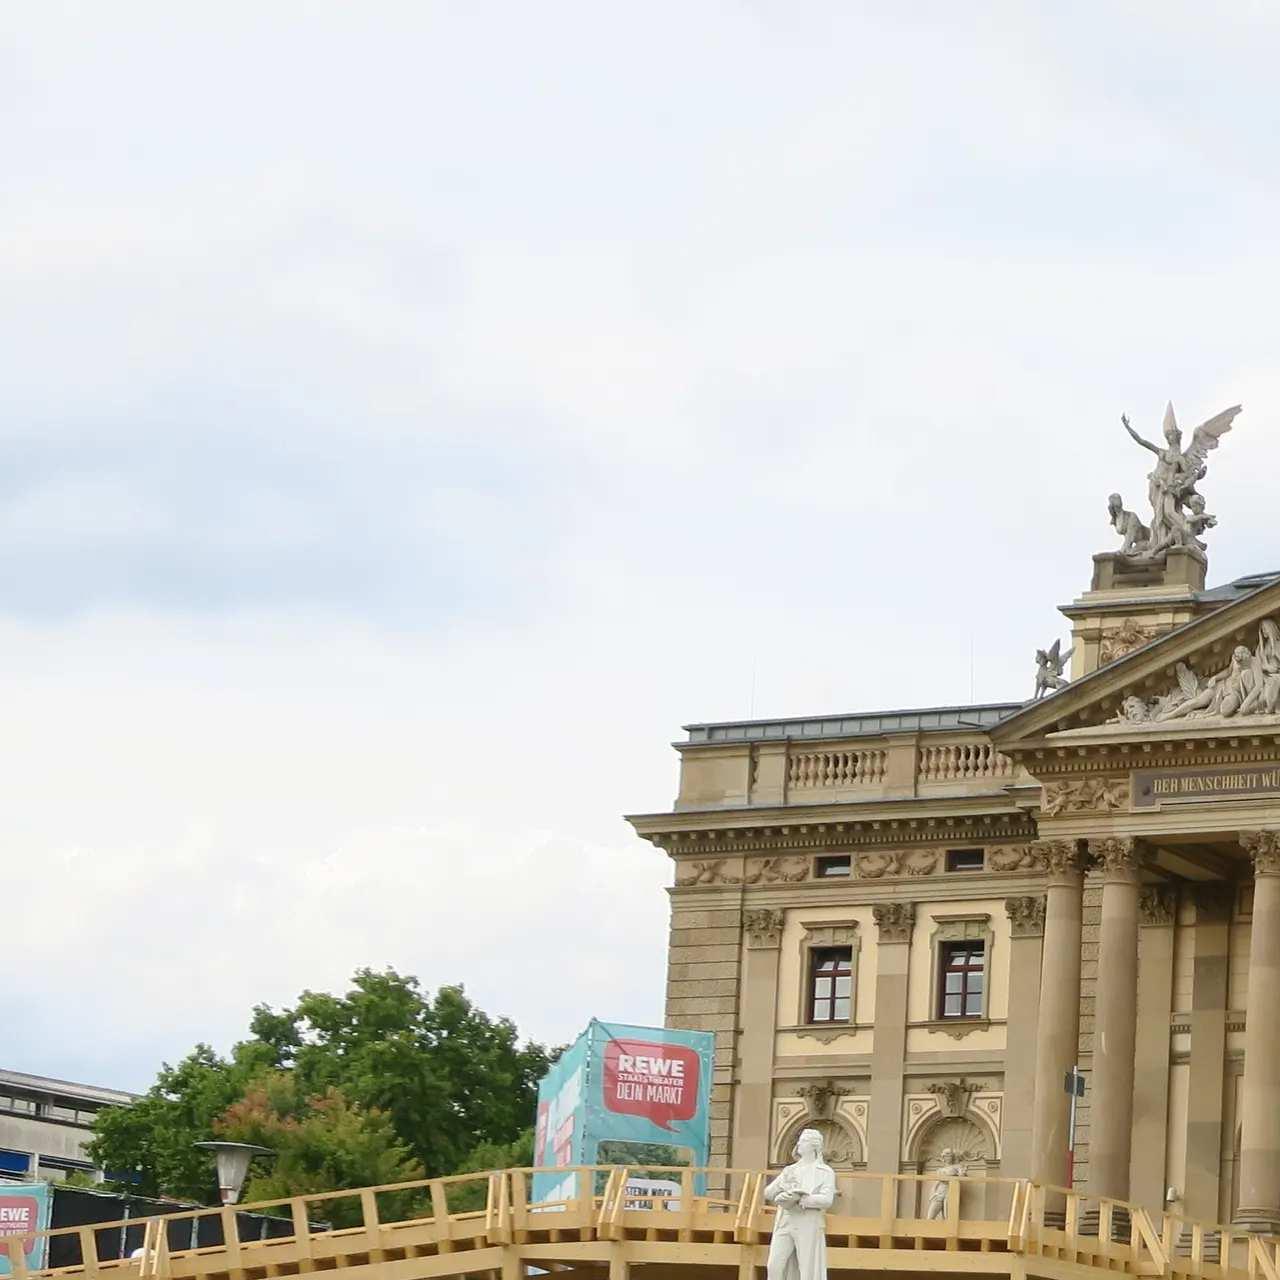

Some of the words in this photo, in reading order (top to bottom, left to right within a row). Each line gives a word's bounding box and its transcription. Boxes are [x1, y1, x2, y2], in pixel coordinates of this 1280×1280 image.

[1153, 777, 1178, 793] DER
[1181, 774, 1257, 792] MENSCHHEIT
[618, 1054, 685, 1077] REWE
[616, 1073, 684, 1086] STAATSTHEATER
[617, 1082, 643, 1101] DEIN
[646, 1085, 684, 1104] MARKT
[0, 1207, 30, 1221] EWE
